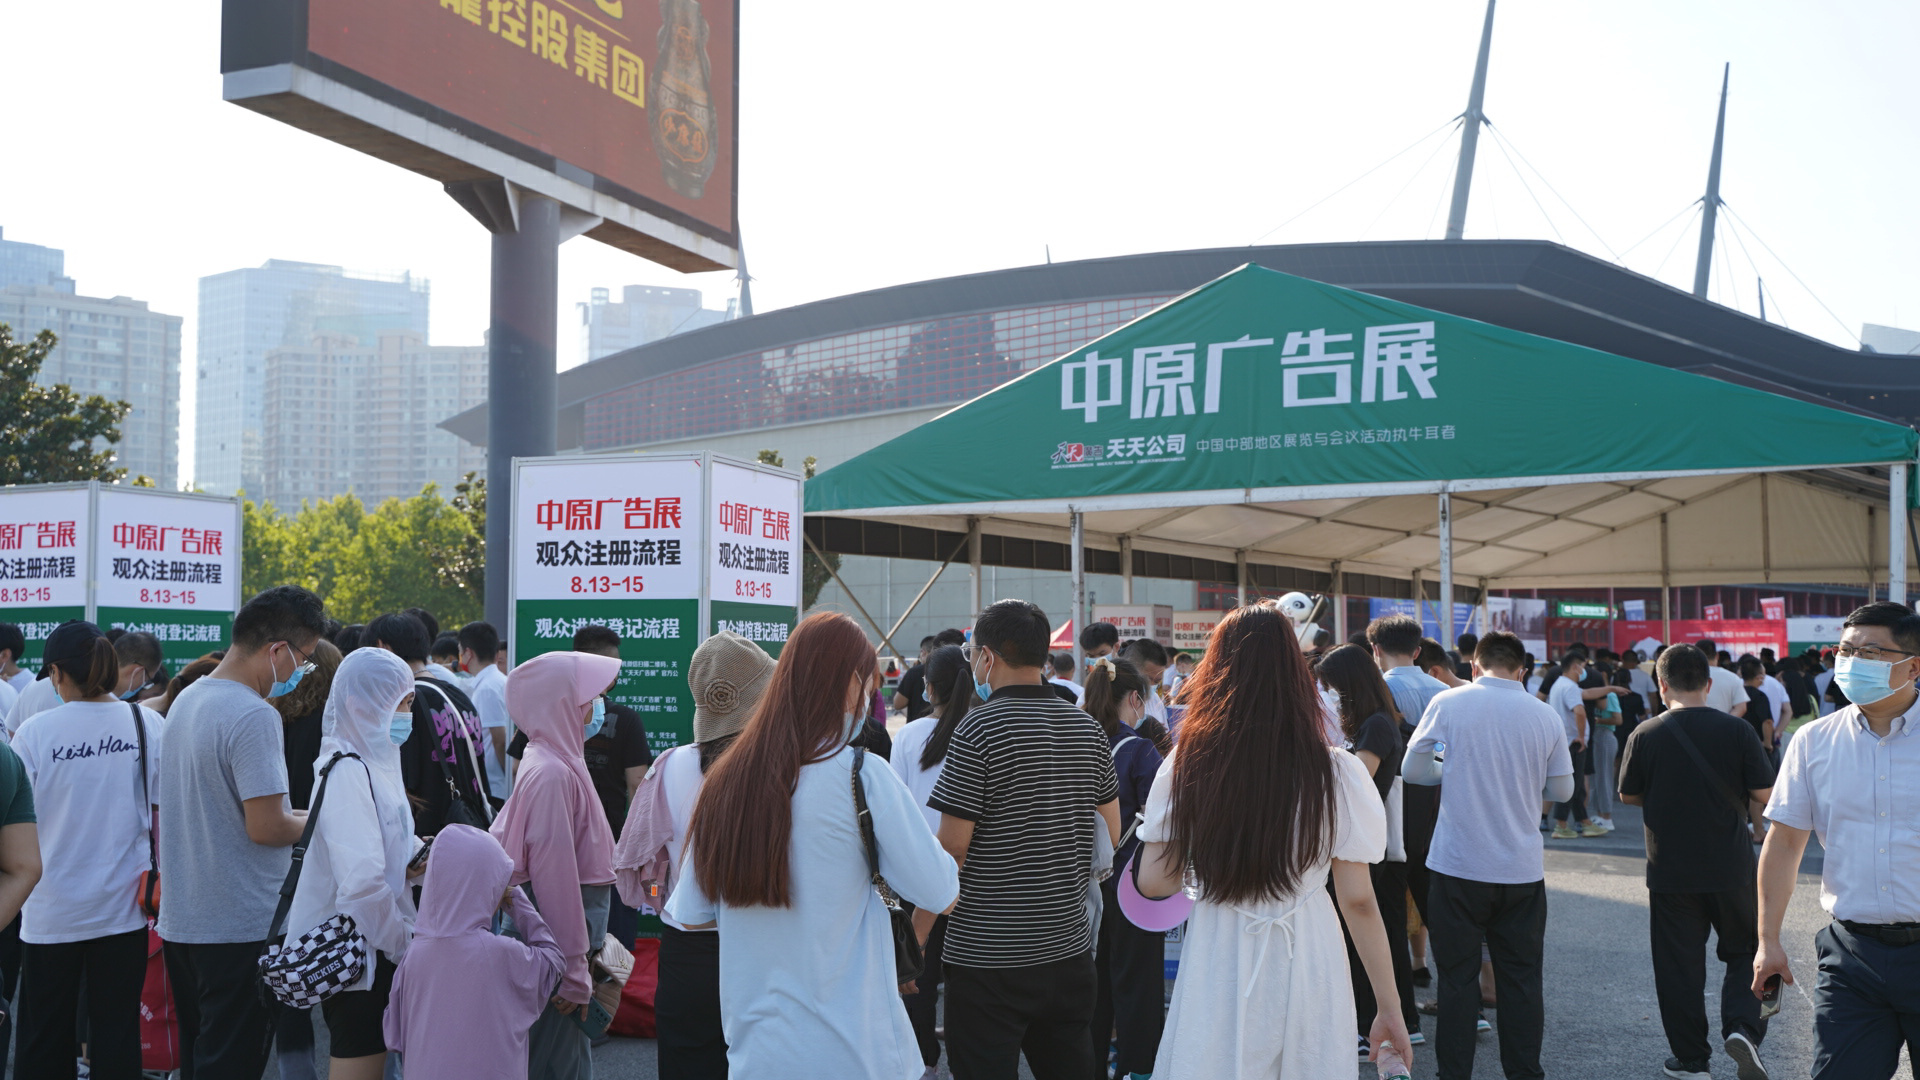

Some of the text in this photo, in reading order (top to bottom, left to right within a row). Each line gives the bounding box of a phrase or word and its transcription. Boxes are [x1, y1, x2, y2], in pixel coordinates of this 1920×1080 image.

[1061, 321, 1438, 422] 中原广告展
[1106, 434, 1186, 459] 天天公司
[1196, 425, 1456, 453] 中国中部地区展览与会议活动执牛耳者
[536, 497, 681, 531] 中原广告展
[719, 500, 790, 541] 中原广告展
[113, 522, 223, 555] 中原广告展
[536, 539, 681, 567] 观众注册流程
[719, 542, 789, 575] 观众注册流程
[112, 557, 222, 584] 观众注册流程
[570, 575, 644, 593] 8.13-15
[1, 587, 50, 602] 8.13-15
[140, 588, 196, 604] 8.13-15
[735, 579, 772, 599] 8.13-15
[52, 742, 95, 762] Keith
[307, 960, 341, 984] DICKIES
